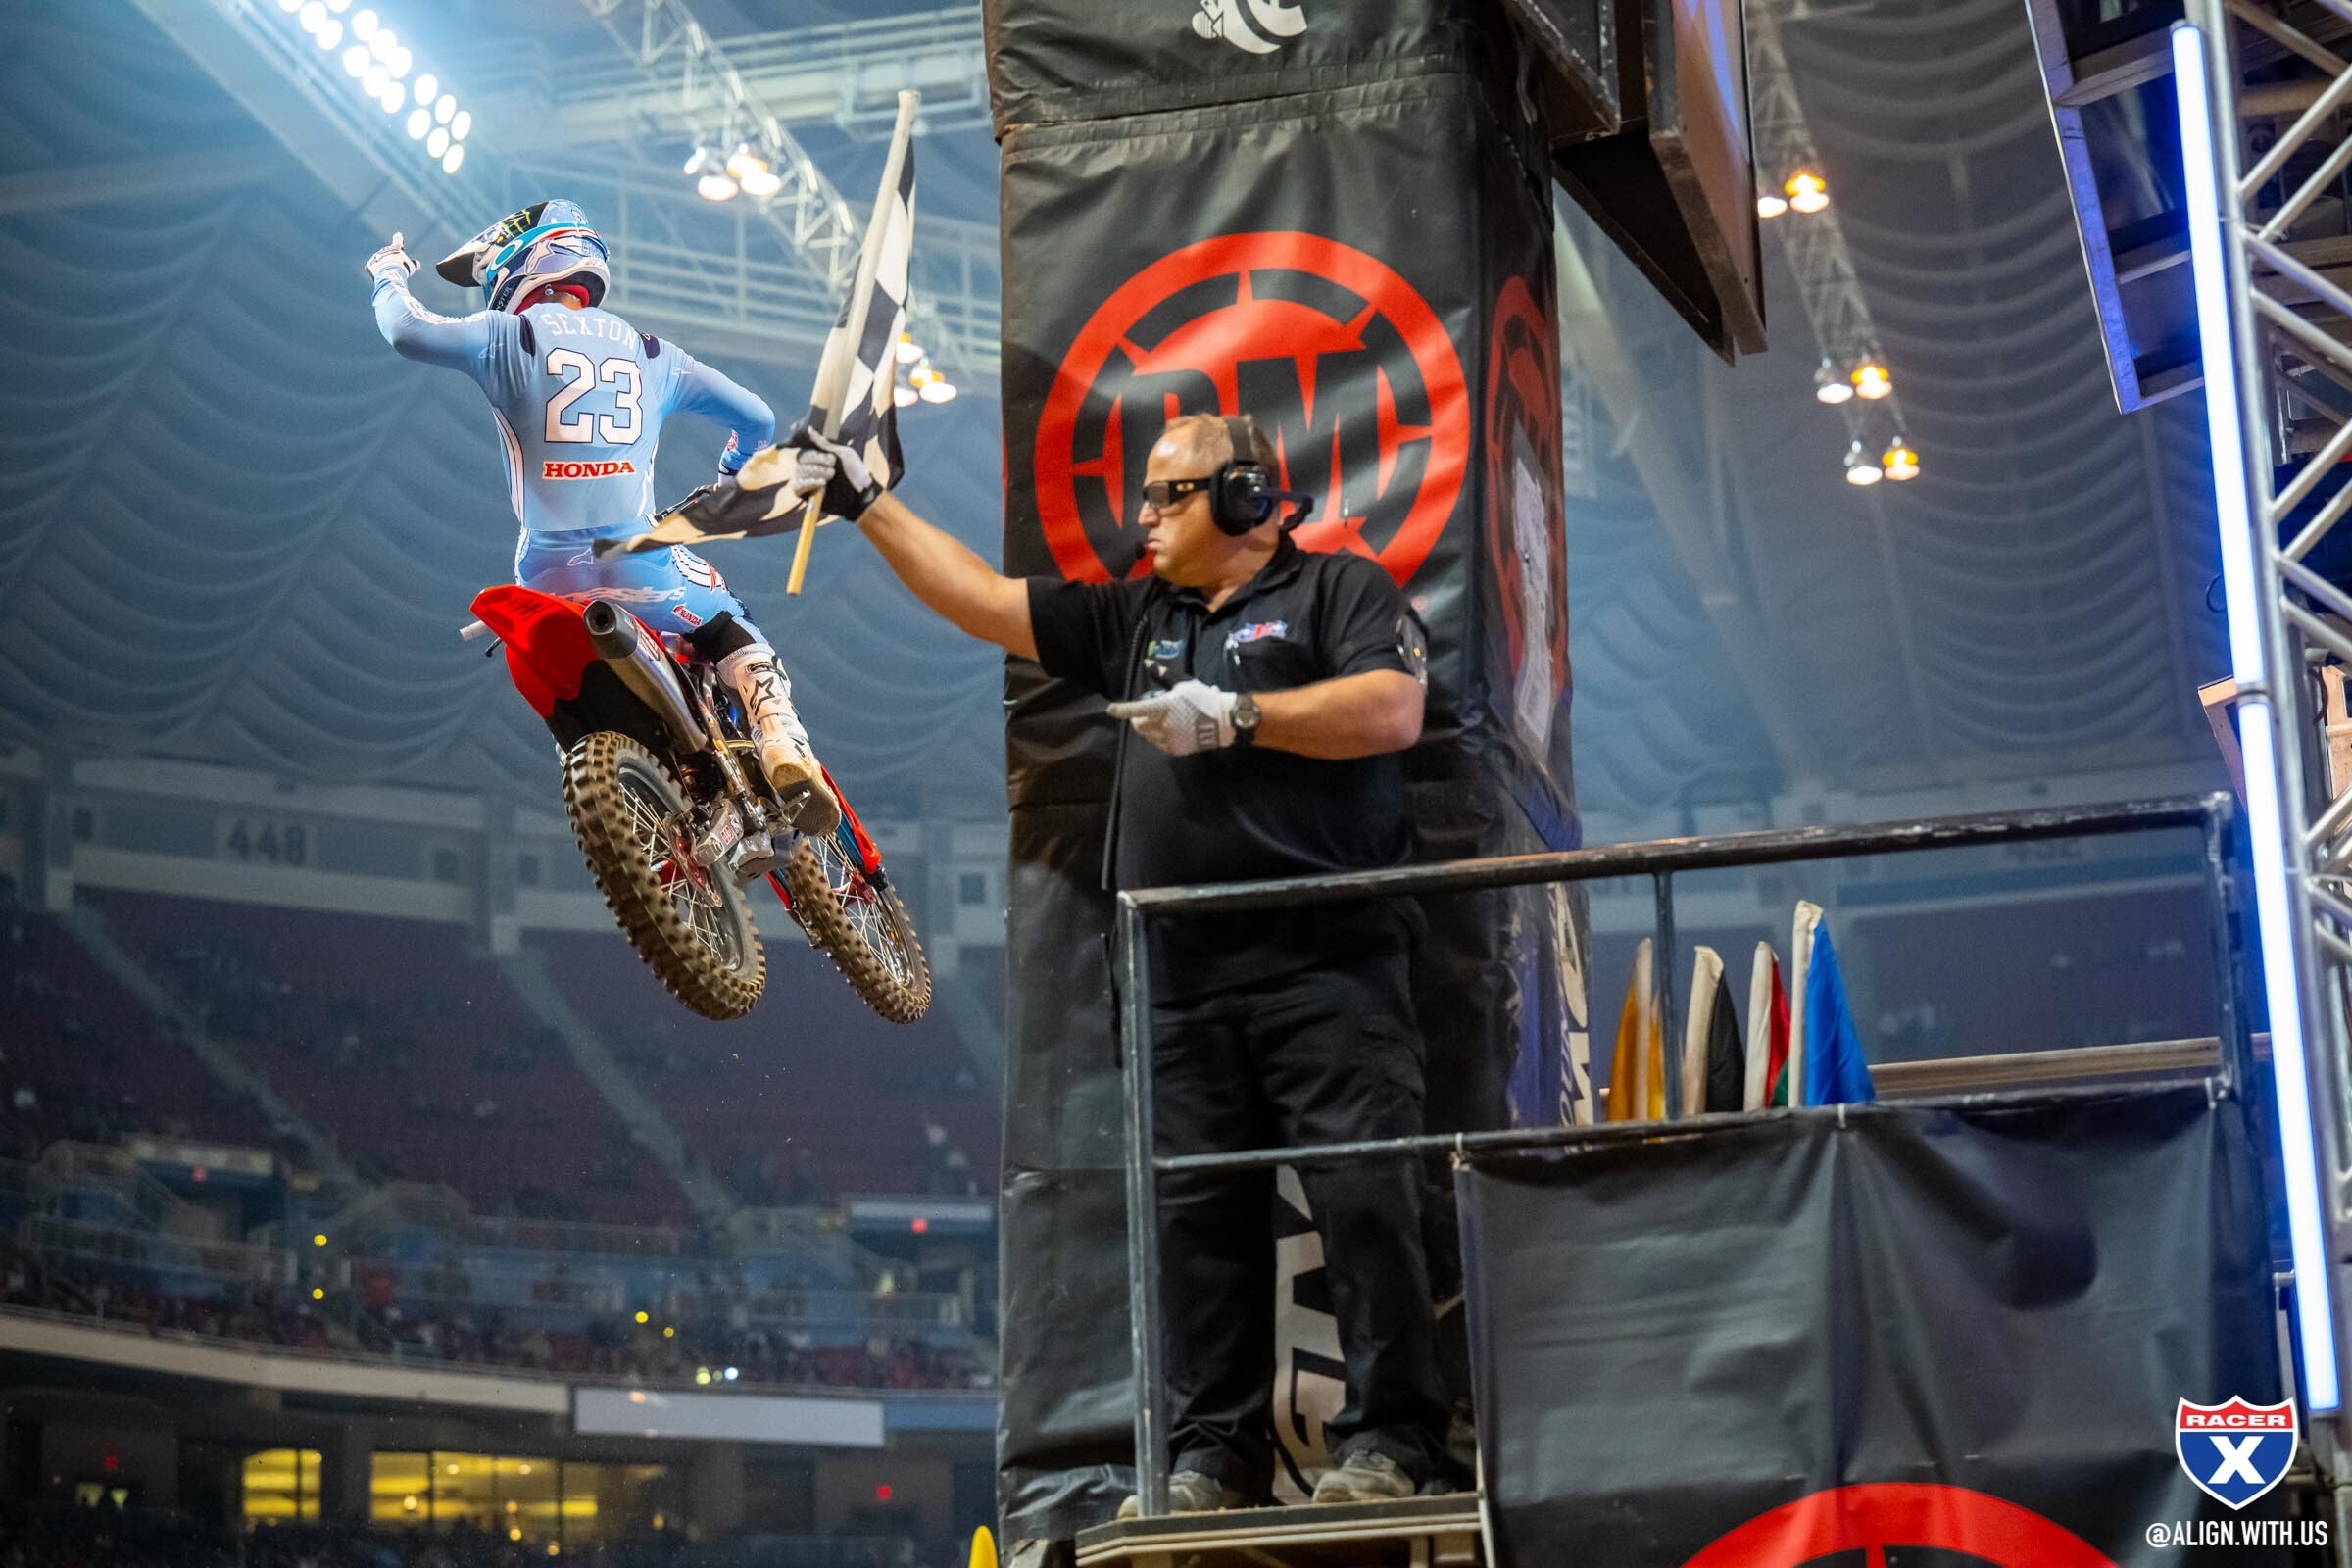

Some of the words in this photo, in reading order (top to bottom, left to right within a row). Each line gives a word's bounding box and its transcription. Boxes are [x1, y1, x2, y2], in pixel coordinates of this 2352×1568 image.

[541, 313, 637, 351] SEXTON
[544, 347, 643, 445] 23
[544, 461, 636, 478] HONDA
